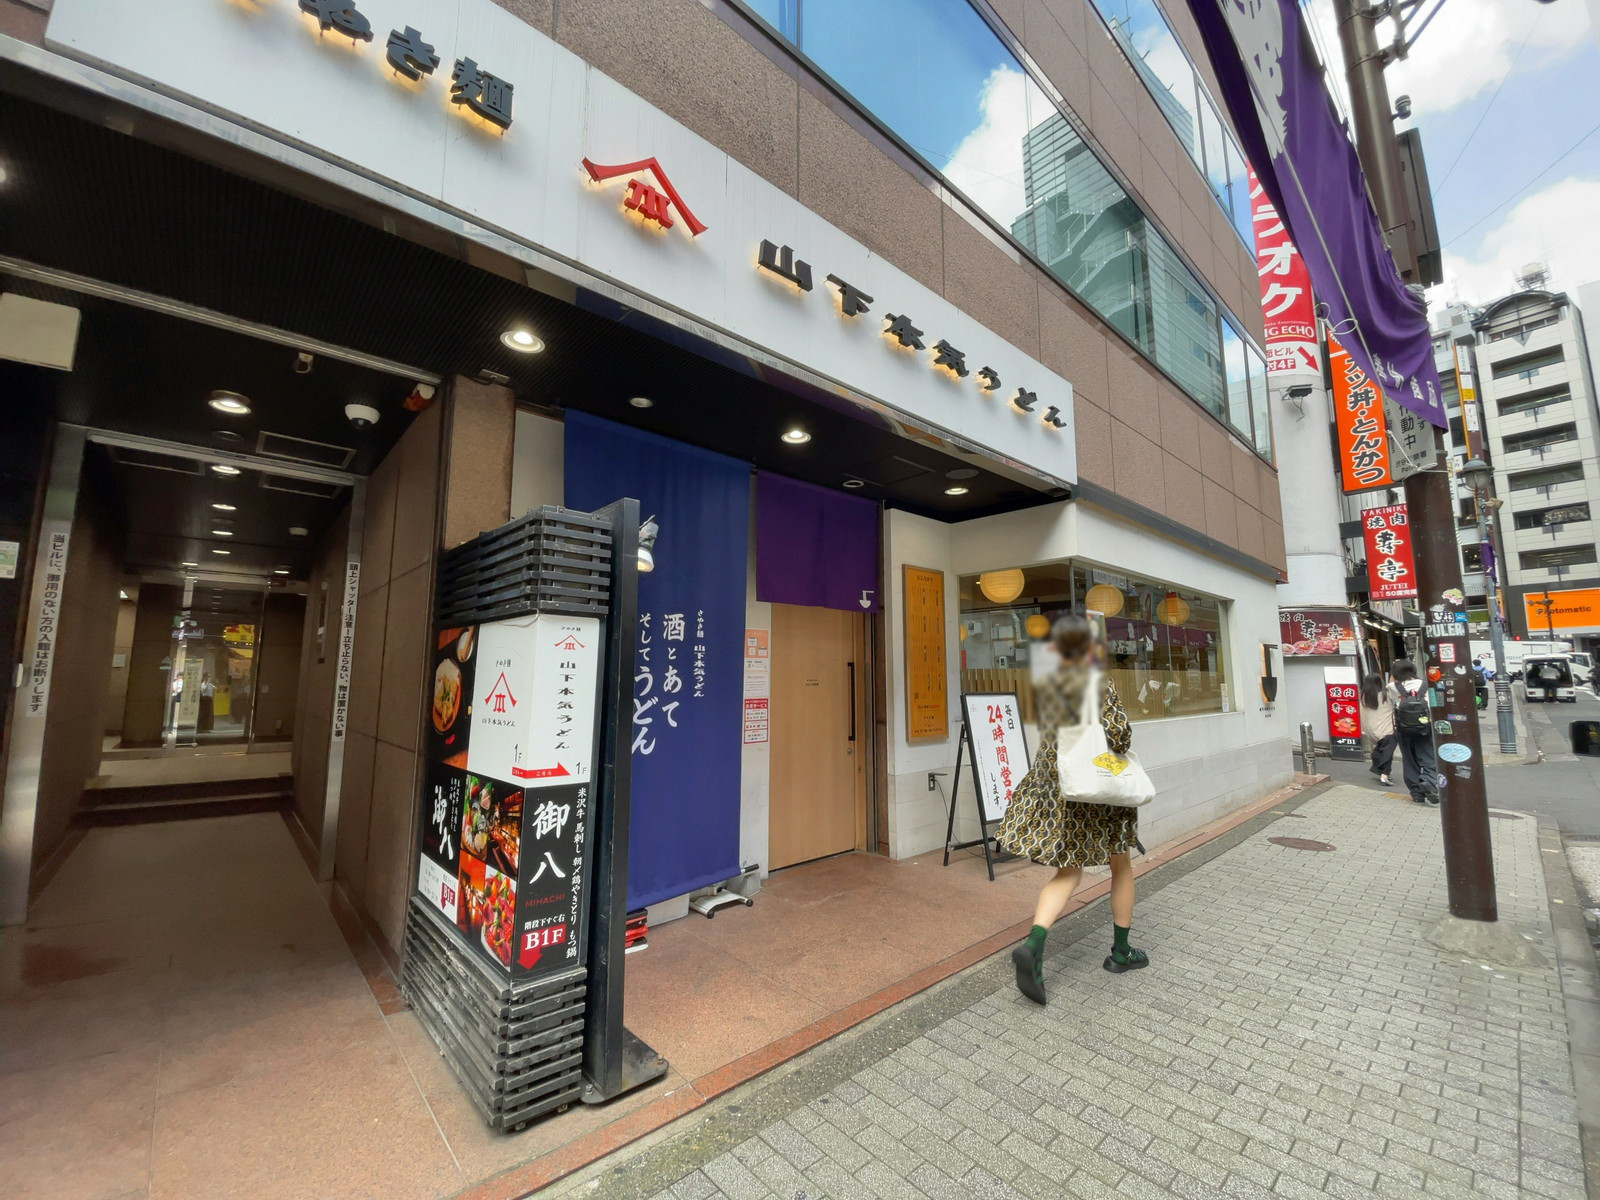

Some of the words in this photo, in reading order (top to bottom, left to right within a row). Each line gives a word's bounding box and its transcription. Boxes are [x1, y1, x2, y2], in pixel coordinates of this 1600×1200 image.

[228, 0, 514, 131] ぬき麺
[757, 238, 1067, 431] 山下本気うどん
[1264, 328, 1279, 338] IG
[1281, 325, 1315, 338] ECHO
[1267, 359, 1295, 371] 付4F
[1367, 512, 1407, 529] 焼肉
[1380, 582, 1408, 591] JUTEI
[1426, 622, 1465, 637] RULER
[631, 612, 659, 755] そしてうどん
[661, 613, 686, 728] 酒とあて
[693, 644, 706, 697] 山下本気うどん
[554, 660, 577, 749] 山下本気うどん
[1004, 703, 1015, 730] 毎日
[482, 717, 516, 727] 山下本気うどん
[575, 761, 587, 775] 1F
[576, 787, 587, 819] 米沢牛
[432, 784, 454, 861] 御八
[529, 801, 571, 884] 御八
[573, 821, 585, 854] 馬刺し
[443, 885, 454, 903] B1F
[523, 893, 566, 908] MIHACHI
[523, 913, 566, 931] 階段下すぐ右
[525, 928, 564, 951] B1F
[565, 929, 577, 959] もつ鍋
